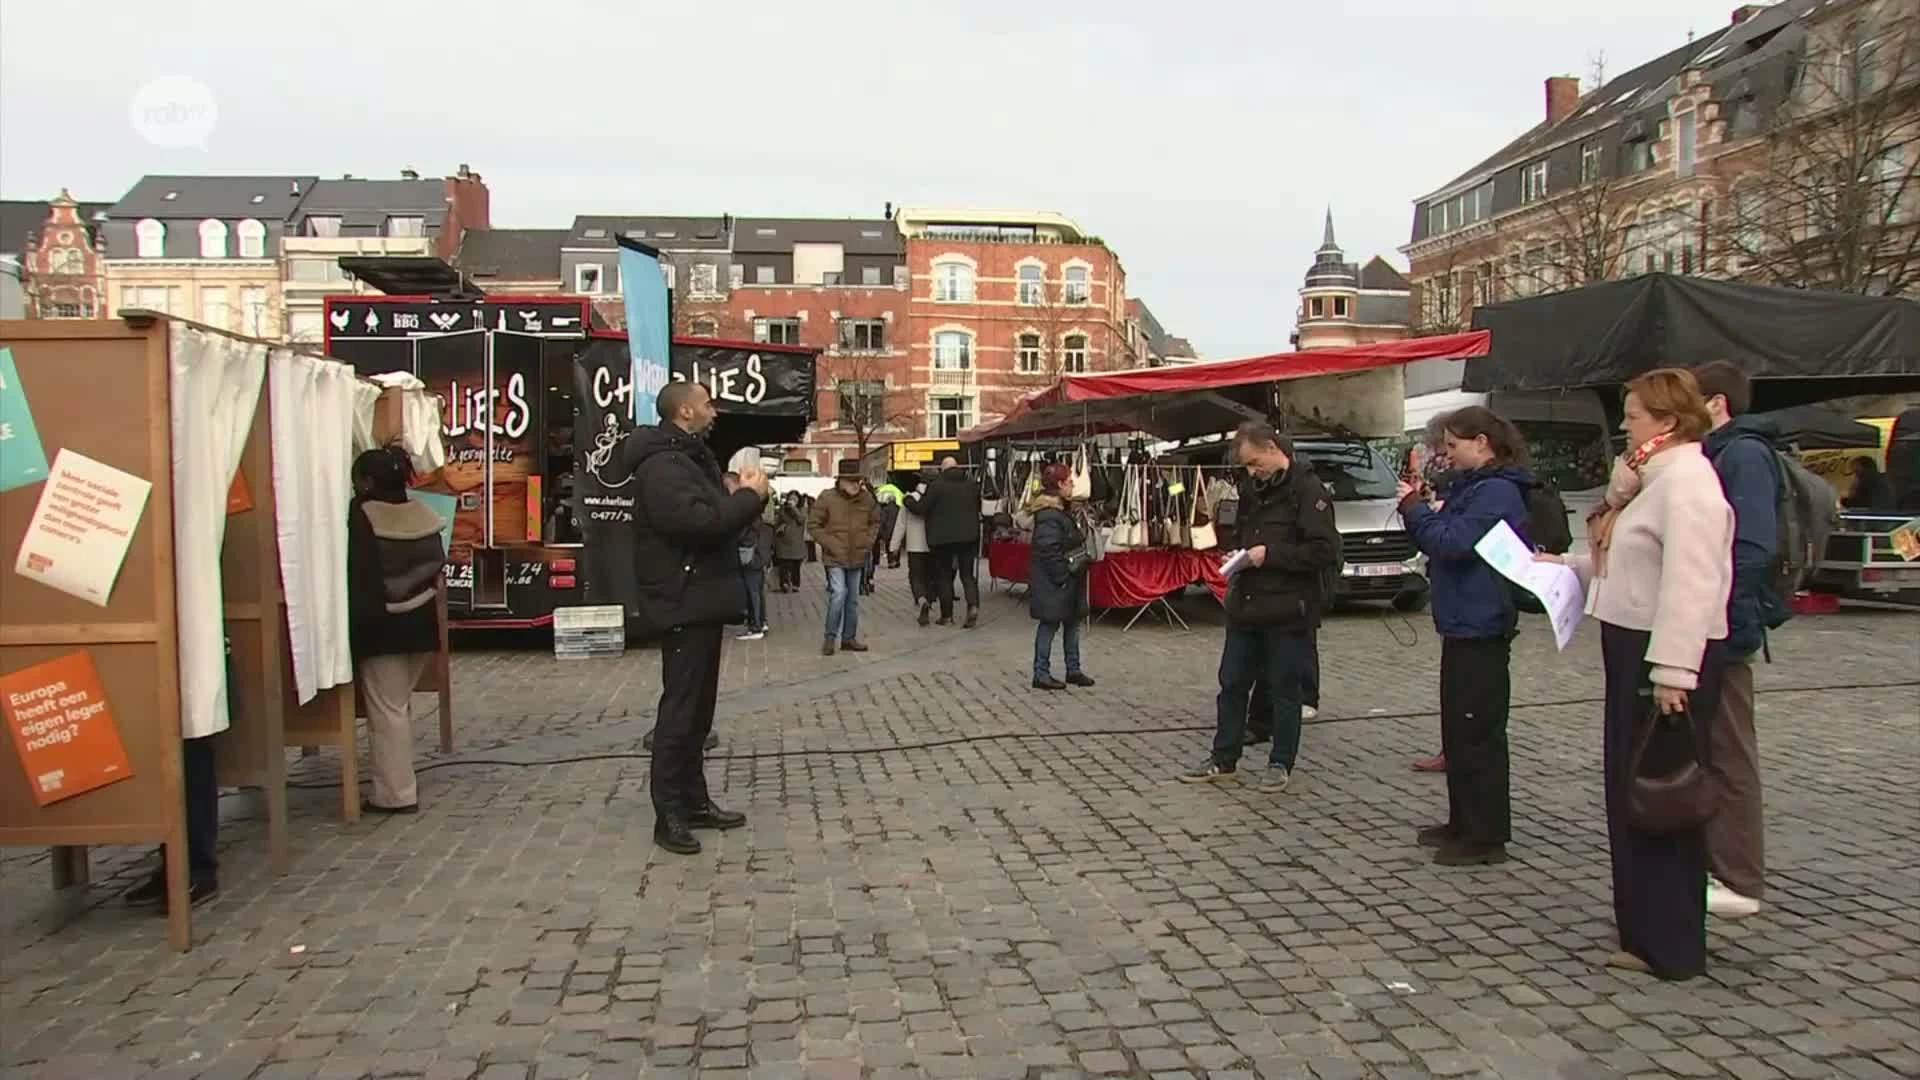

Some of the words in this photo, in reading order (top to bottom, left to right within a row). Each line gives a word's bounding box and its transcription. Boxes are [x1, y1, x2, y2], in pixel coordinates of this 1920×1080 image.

[393, 319, 420, 329] BBQ
[521, 562, 542, 575] 74
[9, 681, 67, 706] Europa
[14, 700, 57, 721] heeft
[59, 690, 88, 707] een
[21, 714, 65, 736] eigen
[66, 701, 105, 721] leger
[27, 723, 79, 751] nodig?
